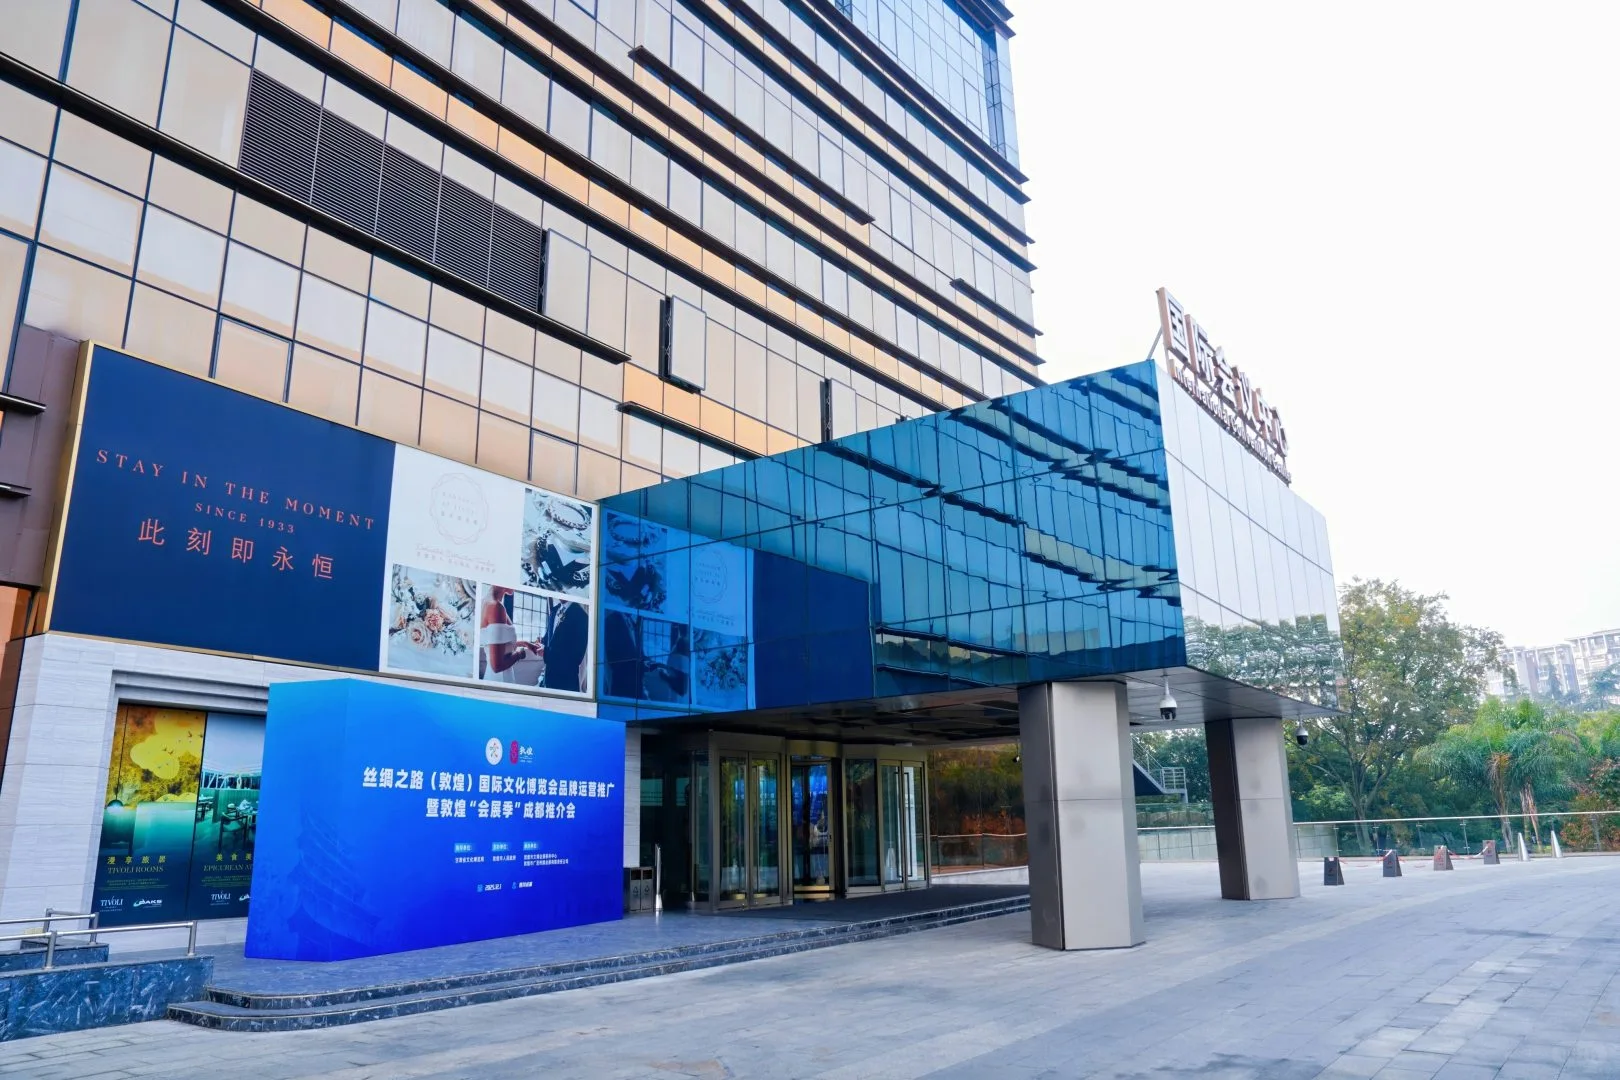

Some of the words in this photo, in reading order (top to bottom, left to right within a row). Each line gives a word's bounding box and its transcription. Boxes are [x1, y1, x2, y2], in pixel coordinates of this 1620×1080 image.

[96, 449, 165, 477] STAY
[180, 470, 208, 489] IN
[225, 481, 271, 505] THE
[284, 498, 376, 530] MOMENT
[195, 502, 248, 523] SINCE
[259, 518, 295, 534] 1933
[137, 517, 334, 579] 此刻即永恒
[107, 866, 134, 874] TIVOLI
[135, 865, 164, 873] ROOMS
[100, 896, 124, 907] TIVOLI
